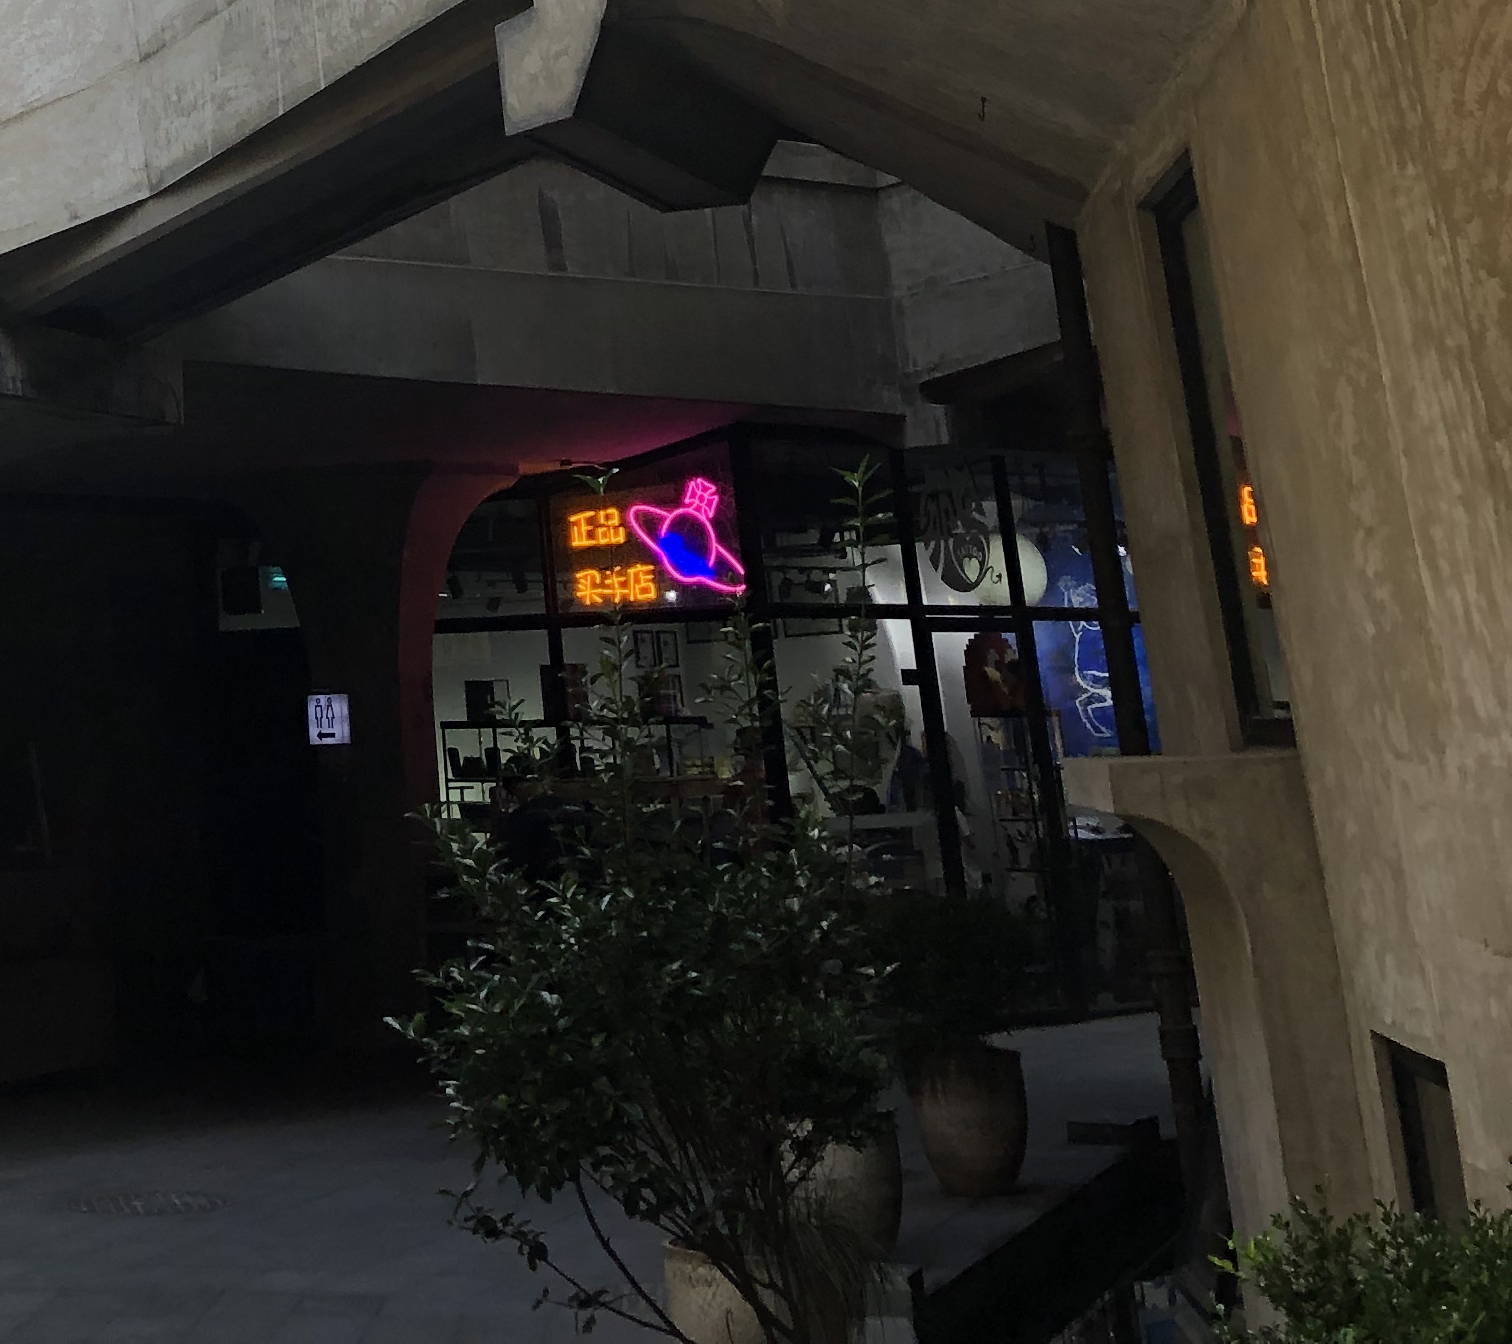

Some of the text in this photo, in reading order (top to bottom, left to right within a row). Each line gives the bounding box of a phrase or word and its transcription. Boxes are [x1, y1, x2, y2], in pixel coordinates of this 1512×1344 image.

[567, 507, 627, 549] 正品
[575, 563, 658, 606] 买手店
